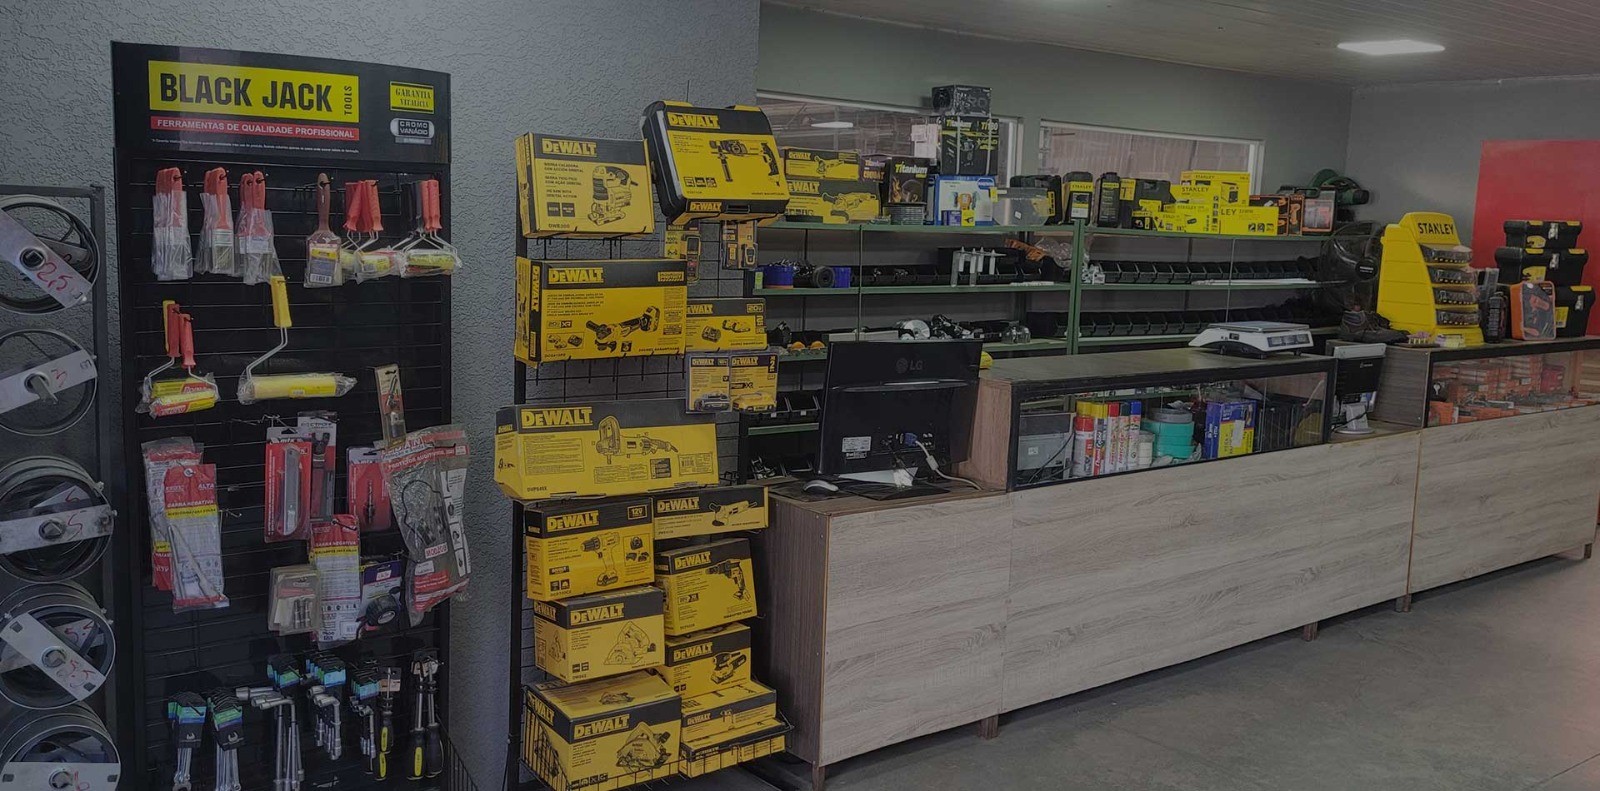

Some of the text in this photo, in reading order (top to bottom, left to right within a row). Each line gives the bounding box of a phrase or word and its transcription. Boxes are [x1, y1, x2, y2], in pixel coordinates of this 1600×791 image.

[160, 73, 333, 113] BLACK JACK
[344, 85, 353, 116] TOOLS
[395, 88, 432, 99] GARANTIA
[157, 119, 355, 139] FERRAMENTAS DE QUALIDADE PROFISSIONAL
[399, 120, 428, 129] CROMO
[667, 112, 720, 130] DEWALT
[542, 139, 598, 157] DEWALT
[895, 161, 928, 174] Titanium
[788, 181, 819, 193] EWALT
[690, 202, 721, 213] DEWALT
[1418, 222, 1454, 235] STANLEY
[548, 268, 604, 284] DEWALT
[910, 360, 923, 371] LG
[520, 408, 593, 427] DEWALT
[631, 508, 643, 516] 12V
[657, 497, 700, 513] DEWALT
[547, 510, 600, 532] DEWALT
[674, 551, 712, 570] DEWALT
[570, 603, 625, 626] DEWALT
[673, 641, 713, 661] DEWALT
[527, 690, 555, 727] DEWALT
[574, 714, 630, 741] DEWALT
[686, 712, 712, 726] DEWALT
